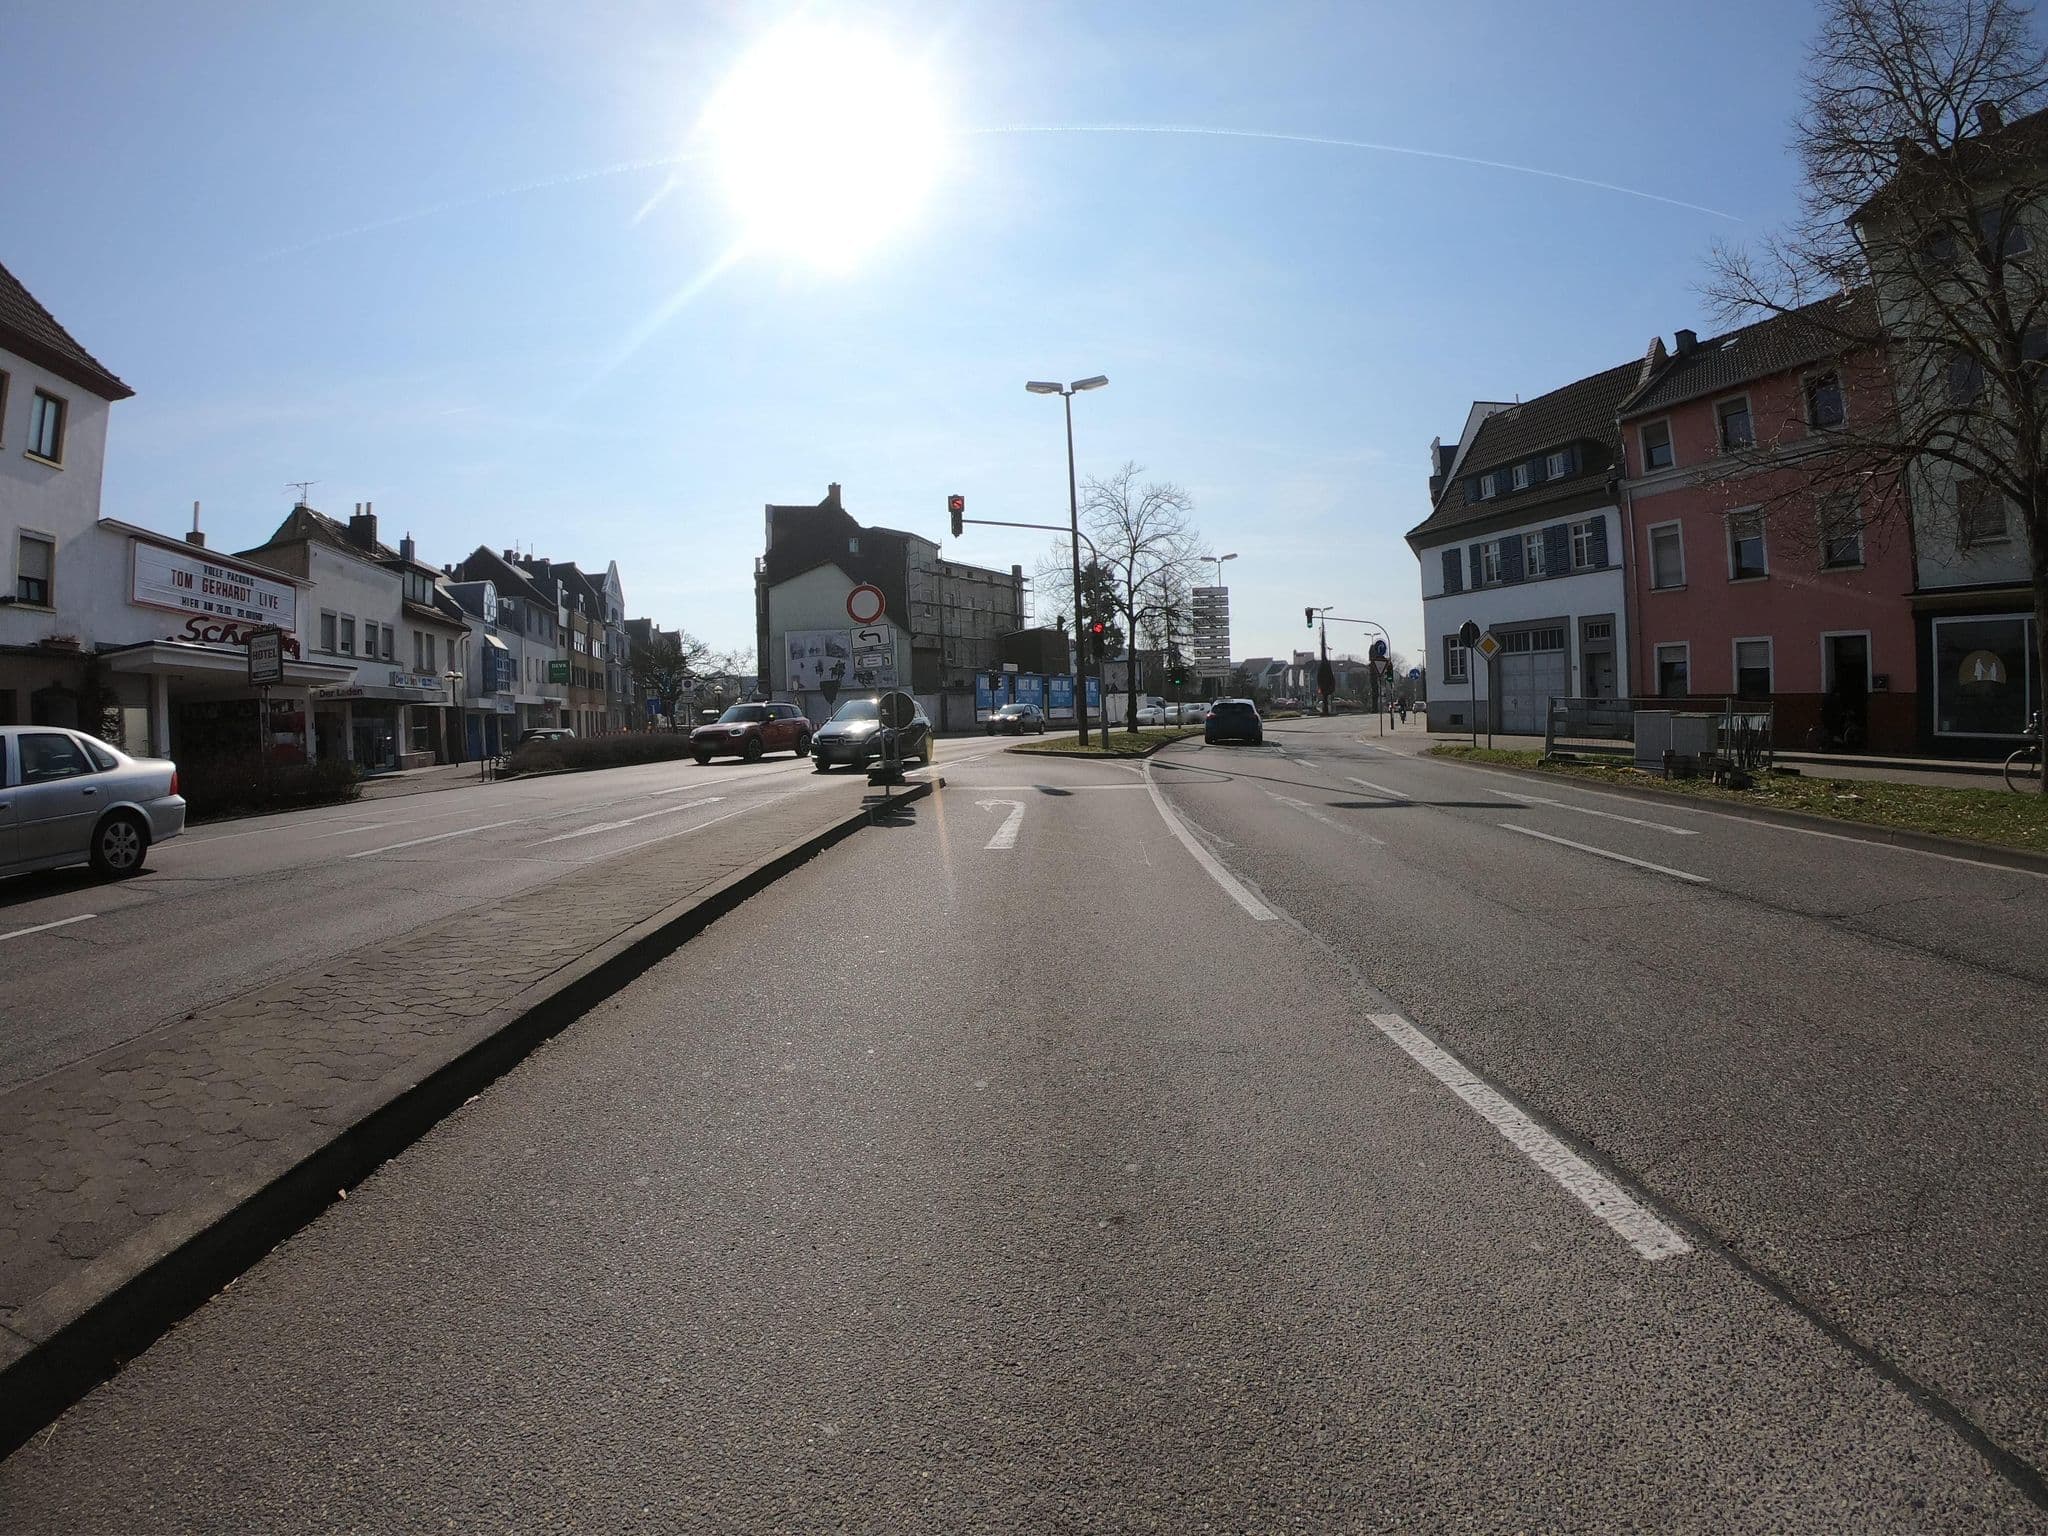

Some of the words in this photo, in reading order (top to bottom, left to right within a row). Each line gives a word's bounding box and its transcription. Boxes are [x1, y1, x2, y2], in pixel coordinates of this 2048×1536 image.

[170, 568, 193, 589] TOM
[202, 577, 252, 603] GERHARDT
[259, 591, 279, 609] LIVE
[181, 596, 199, 609] HIER
[252, 648, 277, 661] HOTEL
